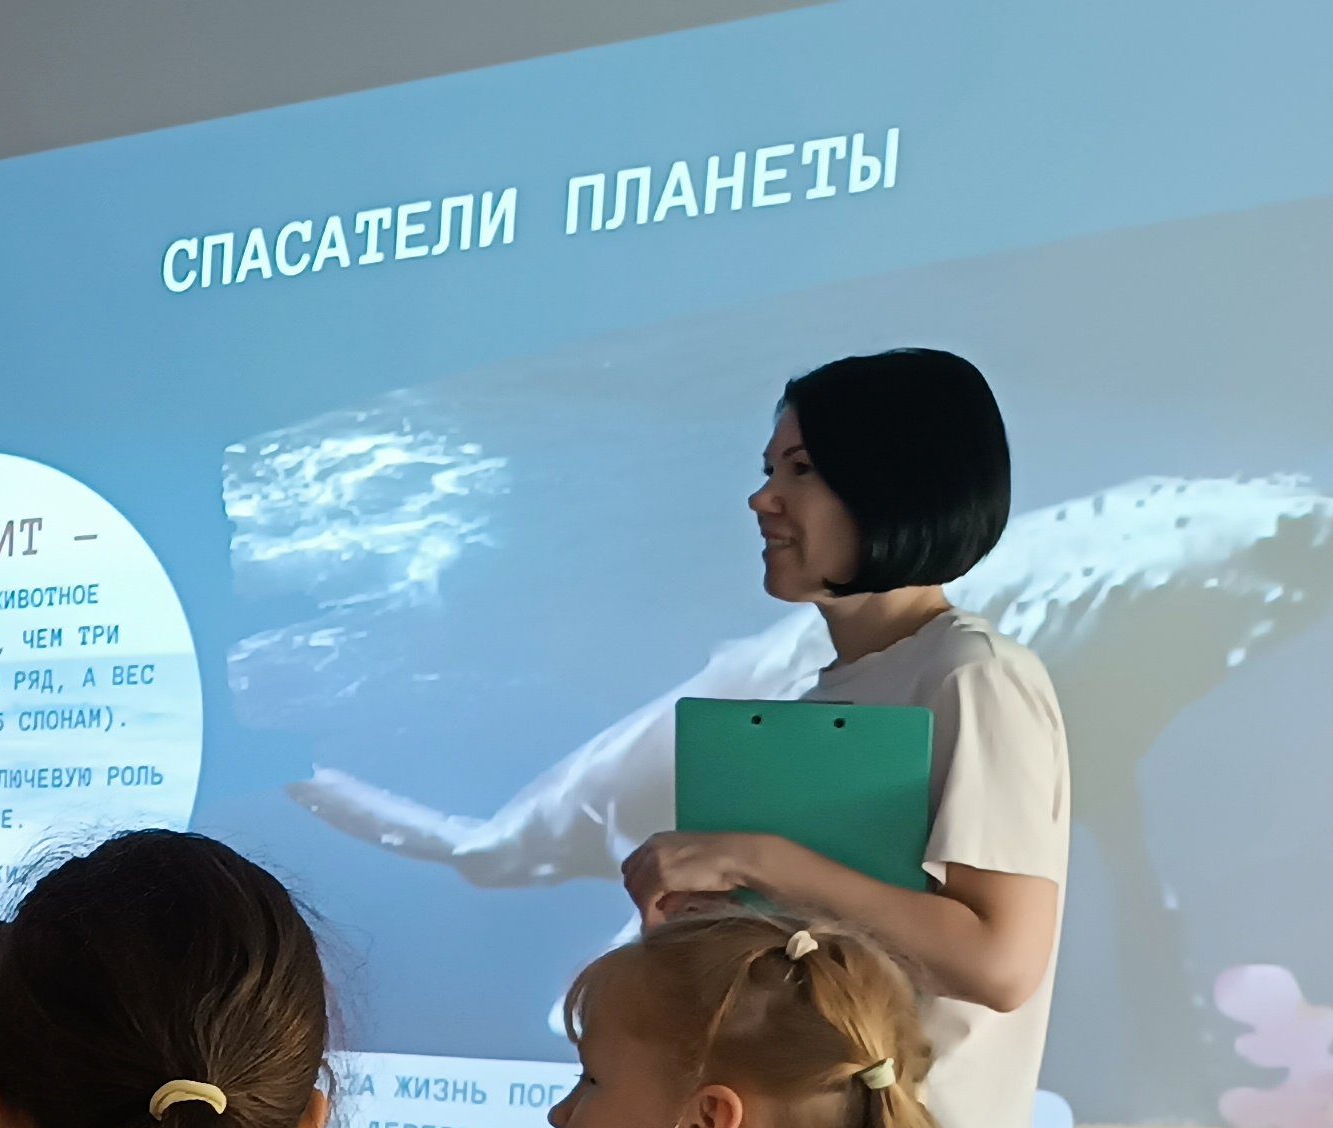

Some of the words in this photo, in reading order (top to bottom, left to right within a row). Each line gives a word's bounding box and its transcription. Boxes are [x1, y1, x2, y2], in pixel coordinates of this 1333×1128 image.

[164, 188, 517, 292] СПАСАТЕЛИ
[566, 128, 899, 234] ПЛАНЕТЫ
[23, 628, 62, 648] ЧЕМ
[78, 625, 119, 645] ТРИ
[14, 669, 63, 693] РЯД,
[83, 668, 95, 687] А
[112, 665, 154, 685] ВЕС
[19, 707, 125, 732] СЛОНАМ).
[107, 766, 163, 786] РОЛЬ
[394, 1076, 486, 1104] ЖИЗНЬ
[509, 1084, 563, 1107] ПОГ
